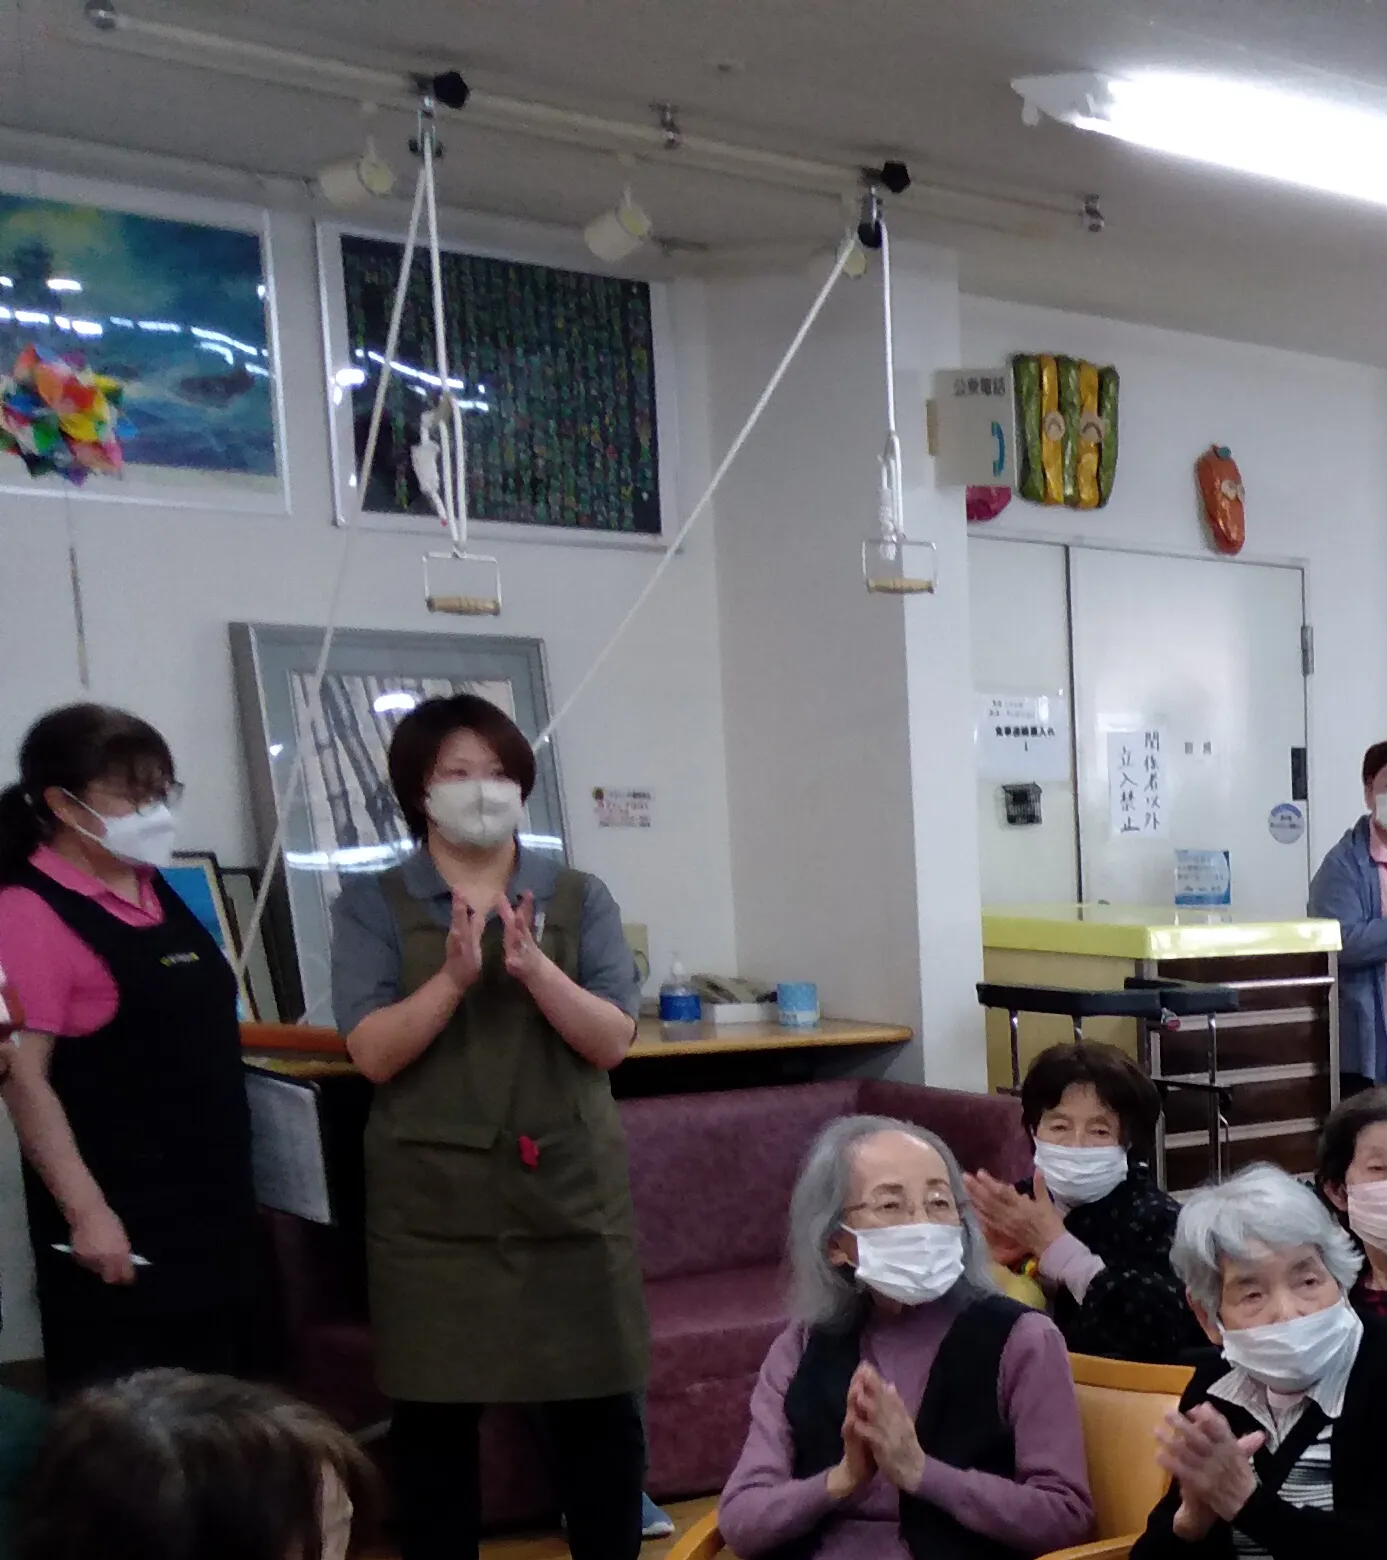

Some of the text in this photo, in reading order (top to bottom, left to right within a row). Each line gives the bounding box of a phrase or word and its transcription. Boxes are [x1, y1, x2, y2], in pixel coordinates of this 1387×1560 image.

[1118, 745, 1141, 834] 立入禁止
[1143, 730, 1162, 831] 関係者以外
